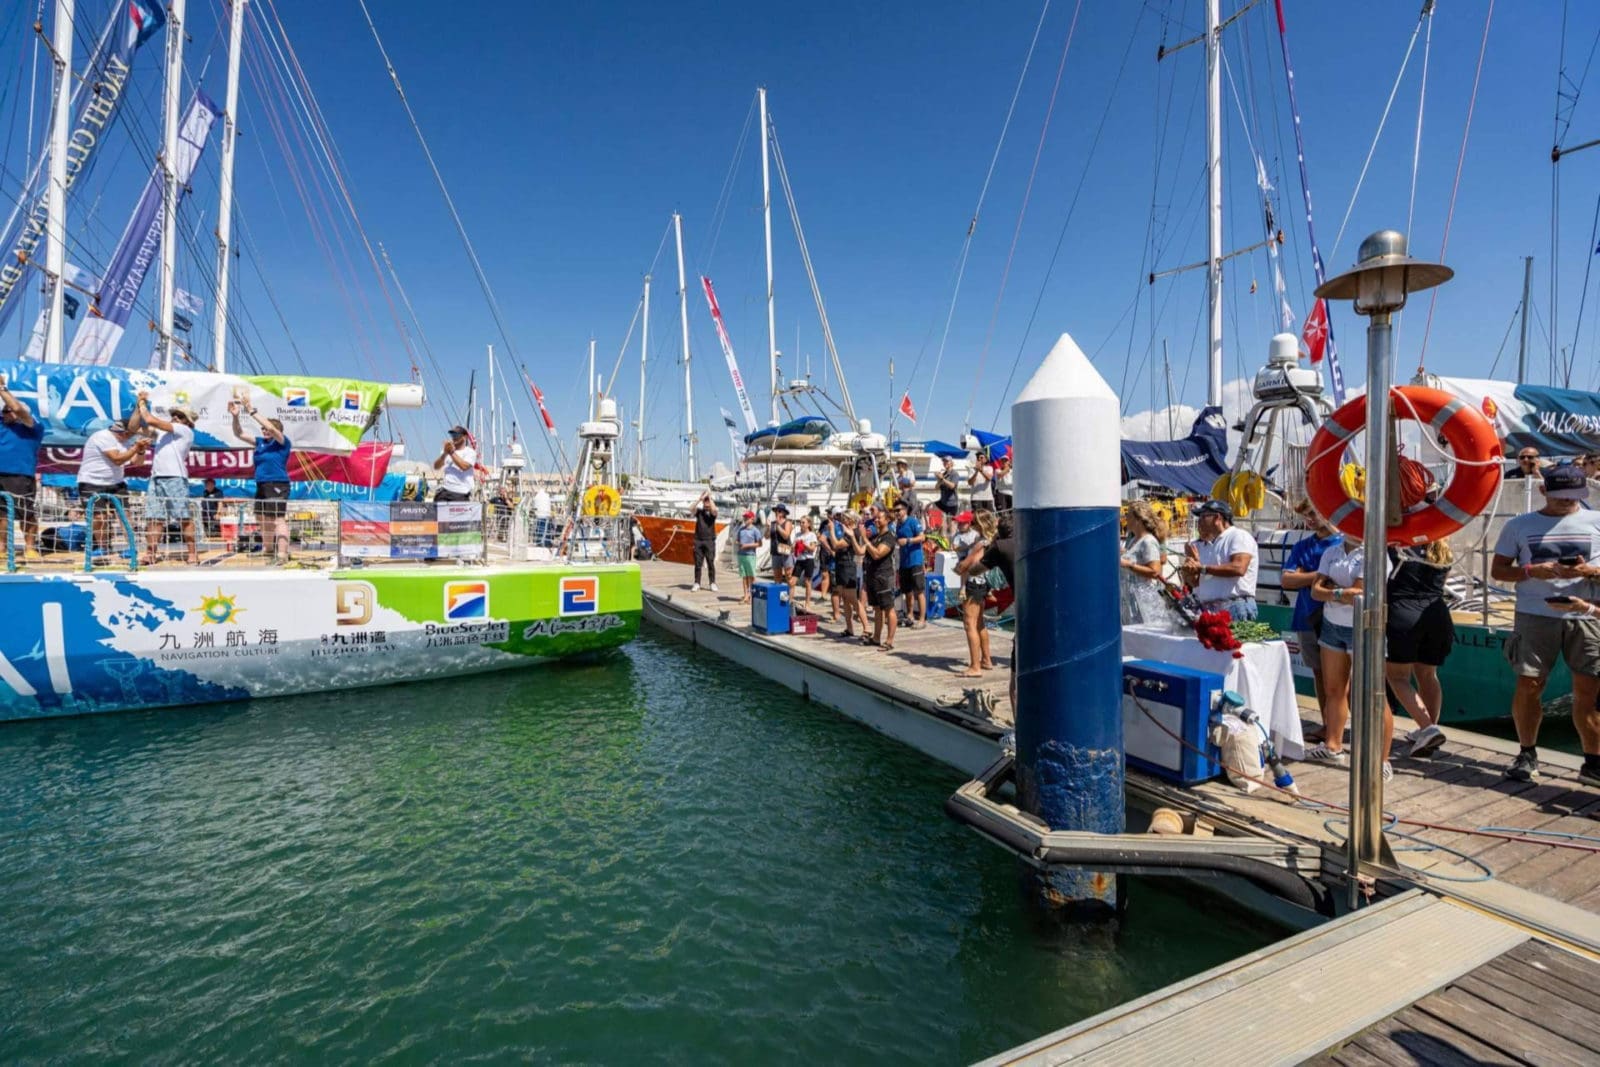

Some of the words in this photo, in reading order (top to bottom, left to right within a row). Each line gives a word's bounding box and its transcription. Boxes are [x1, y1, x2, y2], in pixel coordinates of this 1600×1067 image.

[158, 628, 279, 650] 九洲航海
[161, 650, 229, 661] NAVIGATION
[234, 646, 280, 657] CULTURE
